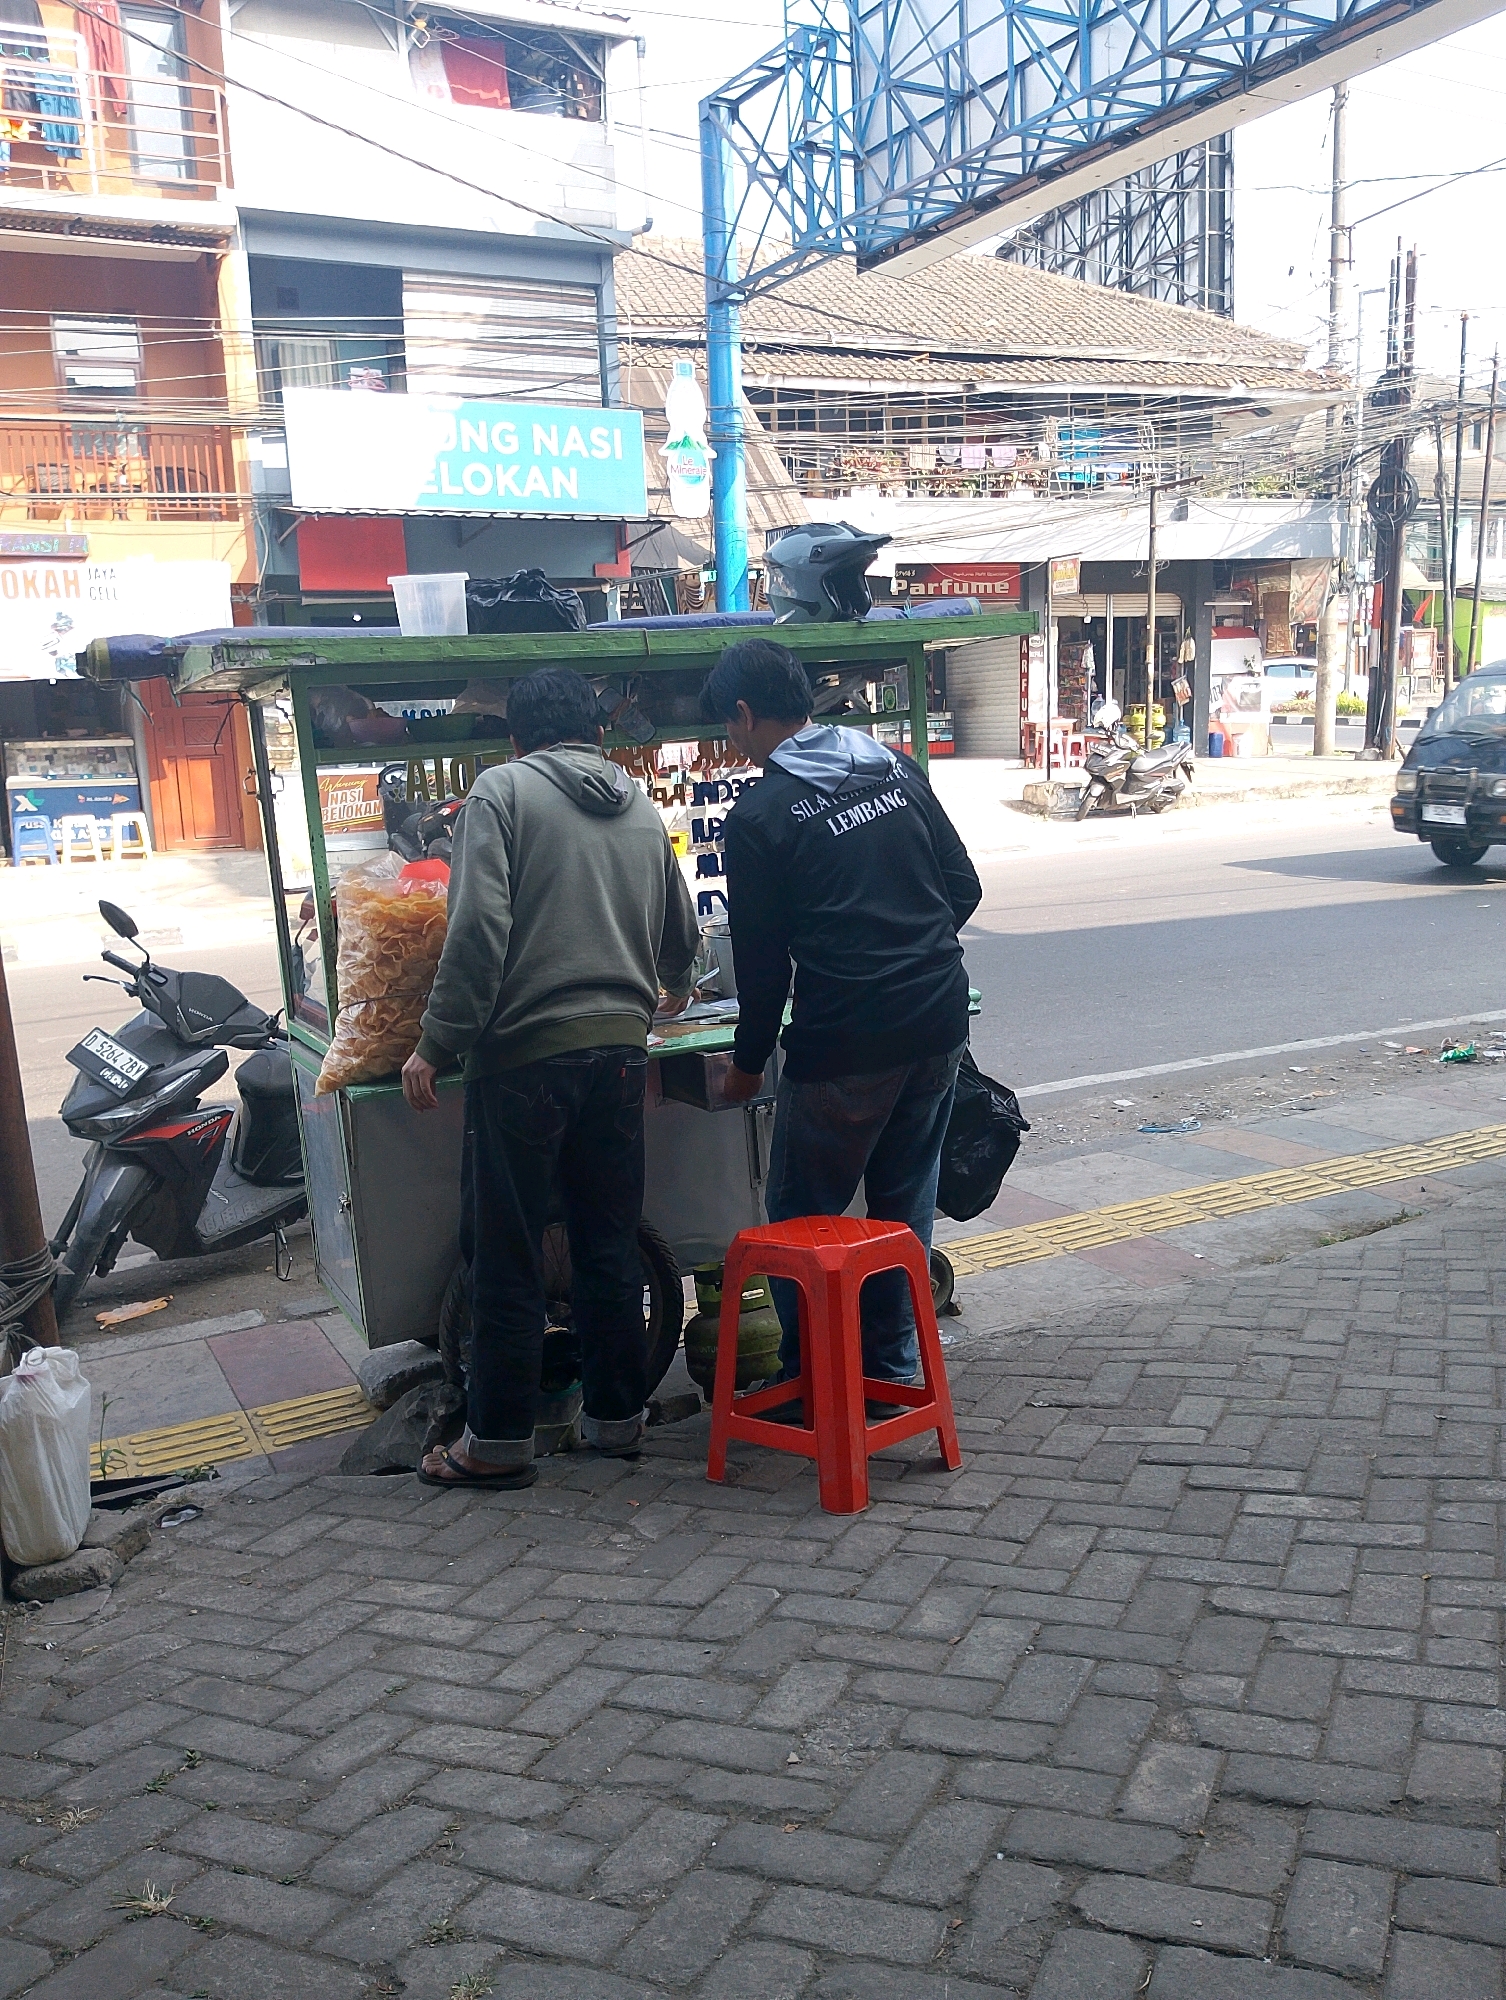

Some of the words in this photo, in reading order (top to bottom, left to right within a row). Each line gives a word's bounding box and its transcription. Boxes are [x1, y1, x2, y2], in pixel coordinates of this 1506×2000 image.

[532, 423, 623, 460] NASI
[670, 464, 707, 475] Minerale
[682, 455, 693, 466] Le
[89, 586, 118, 600] CELL
[892, 578, 1010, 596] Parfume
[329, 789, 363, 806] NASI
[322, 801, 382, 823] BELOKAN
[826, 788, 907, 837] LEMBANG
[188, 1007, 214, 1022] HONDA
[85, 1033, 99, 1047] D
[95, 1041, 124, 1065] 5264
[187, 1115, 222, 1136] HONDA
